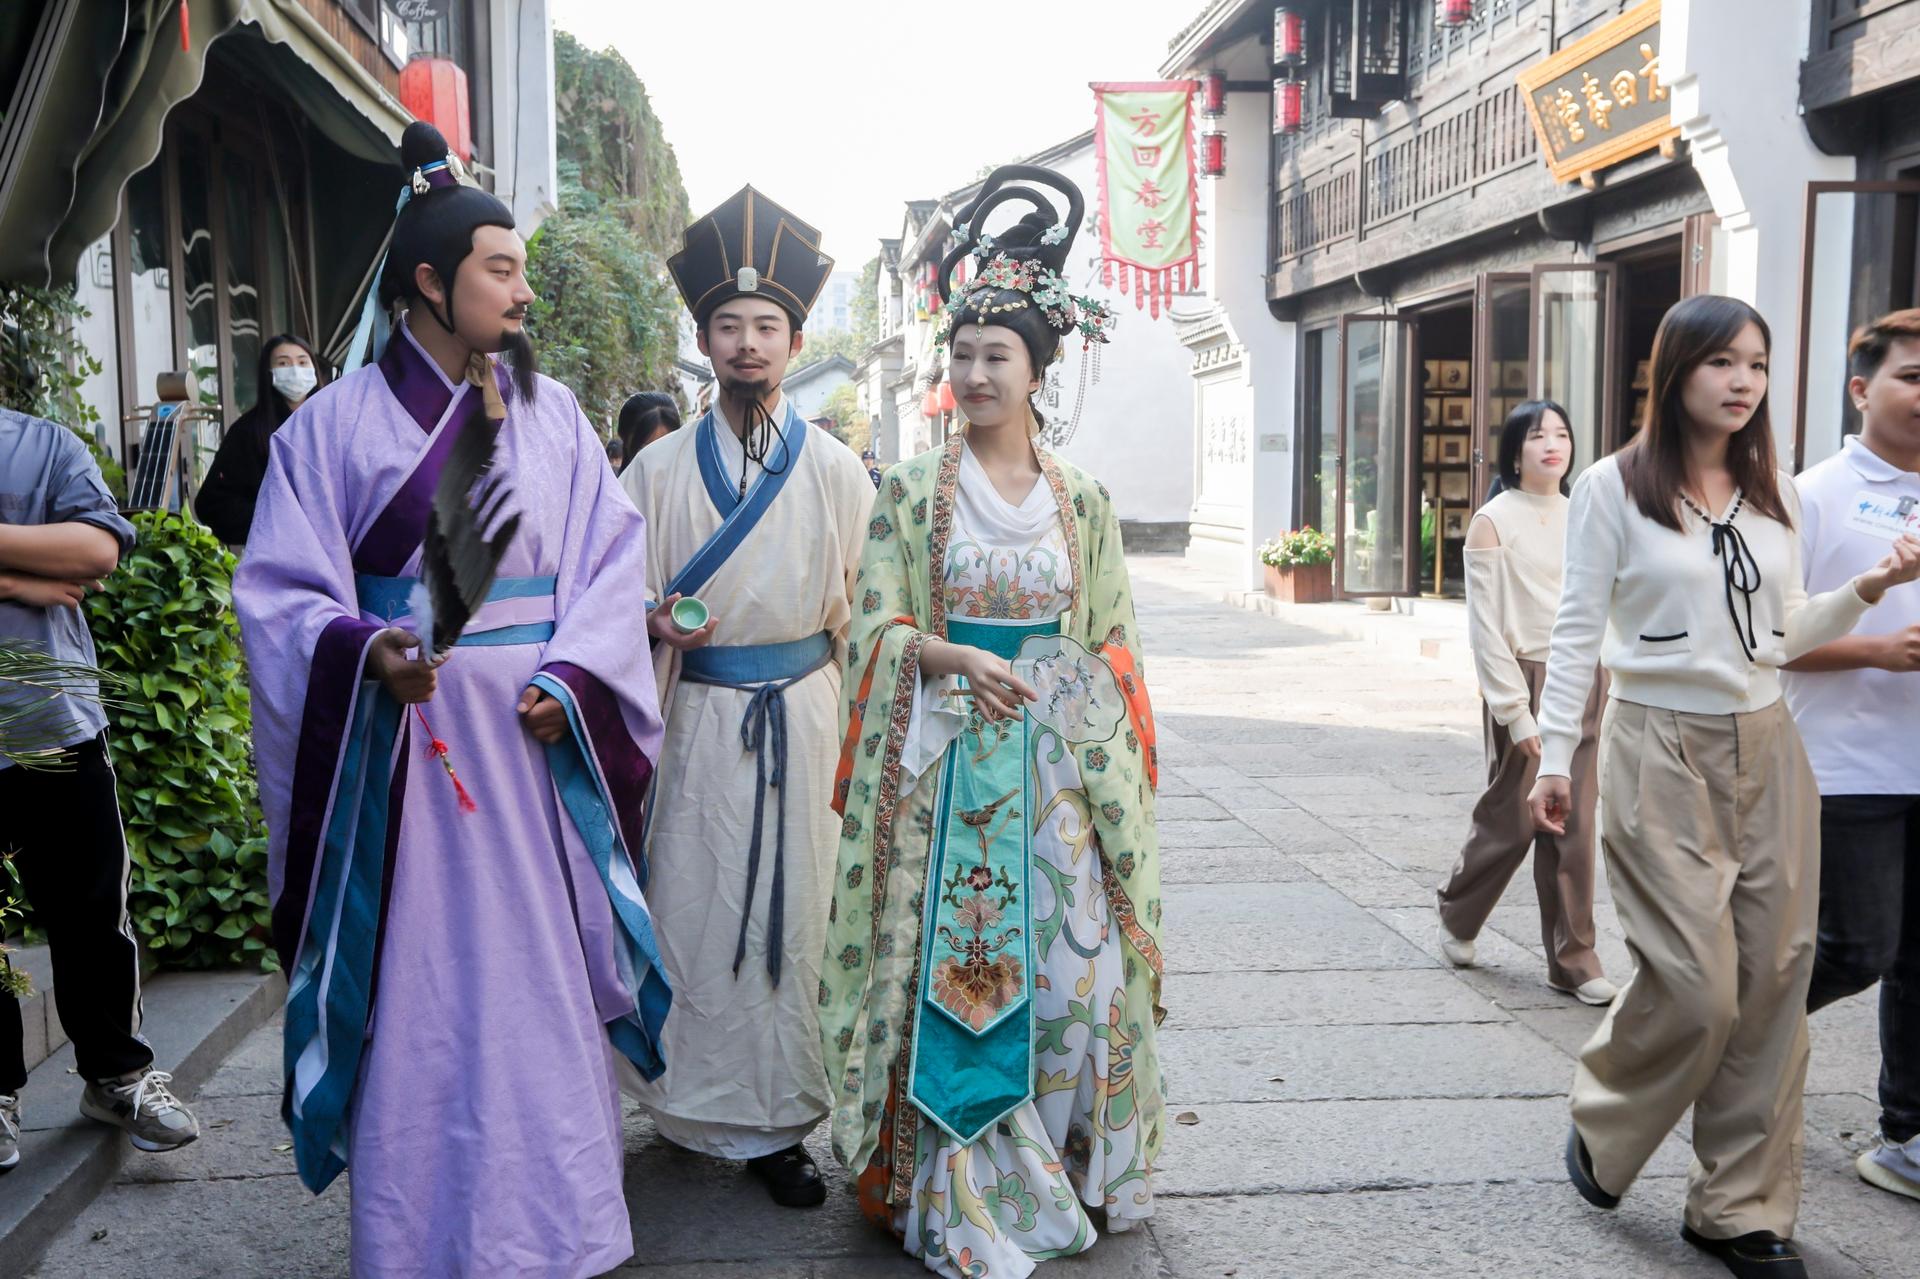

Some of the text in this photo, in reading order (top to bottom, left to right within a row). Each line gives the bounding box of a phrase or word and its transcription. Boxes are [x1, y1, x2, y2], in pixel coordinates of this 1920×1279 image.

[396, 0, 438, 20] Coffee
[1130, 108, 1168, 248] 方回春堂
